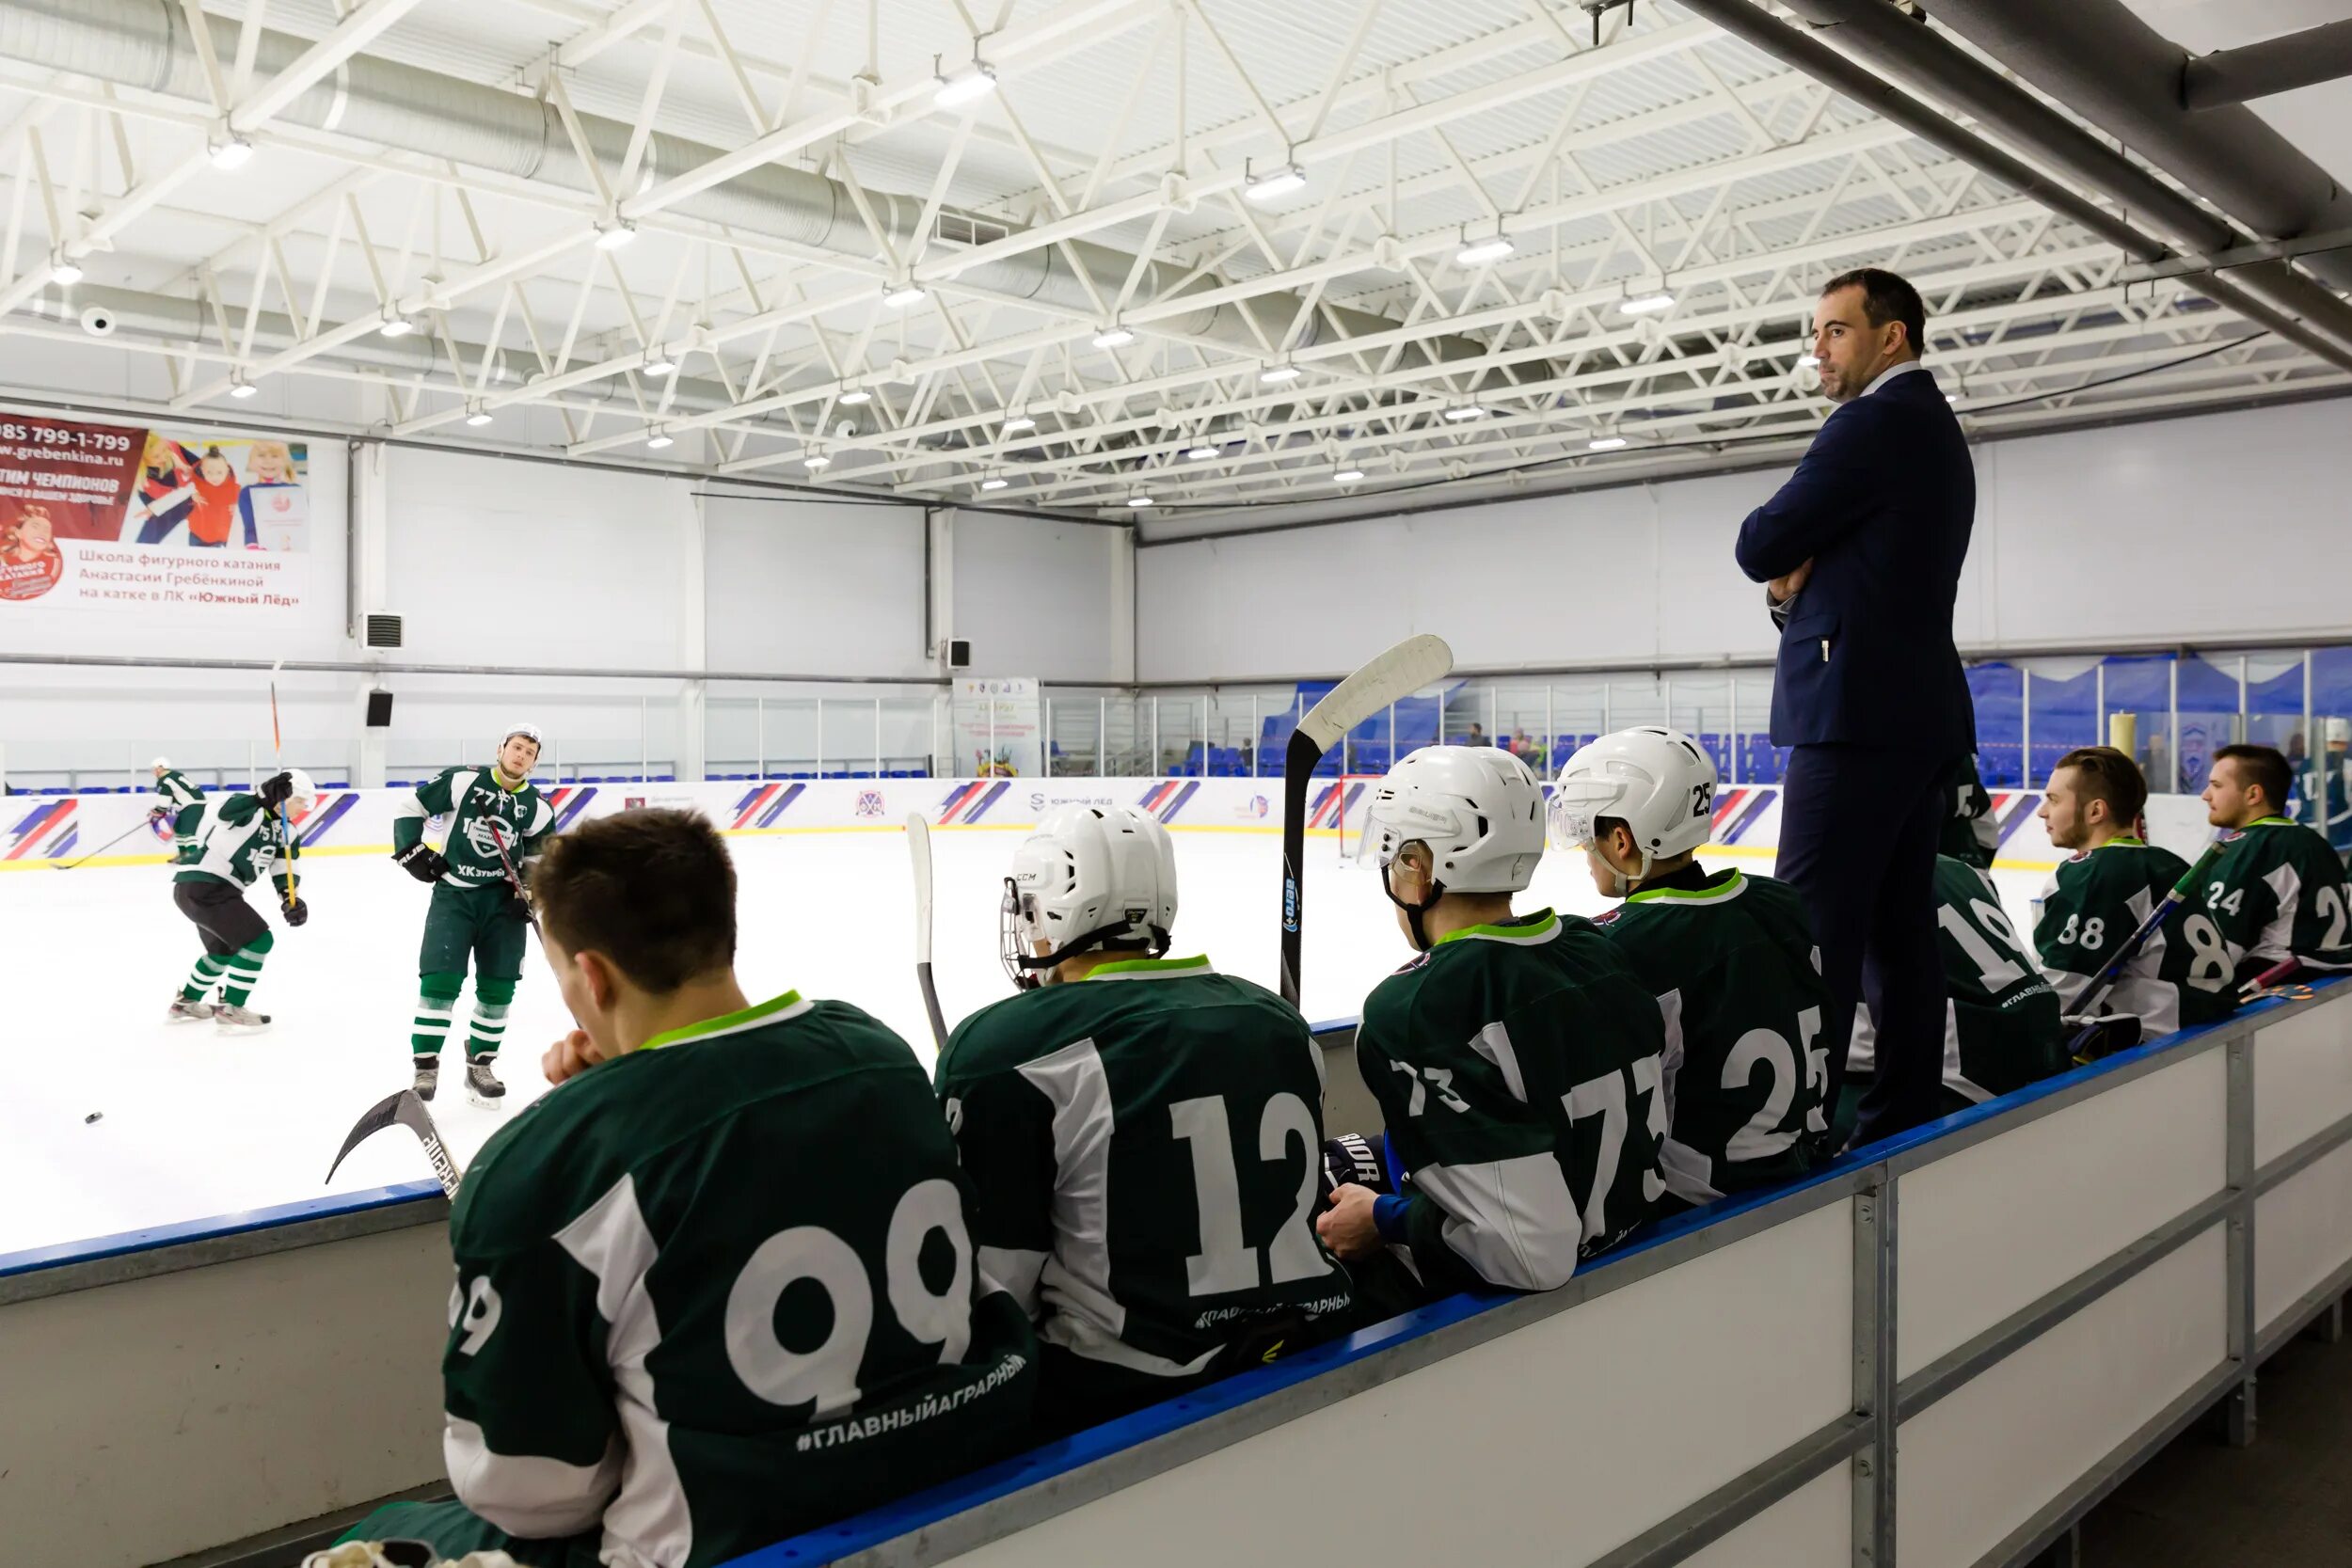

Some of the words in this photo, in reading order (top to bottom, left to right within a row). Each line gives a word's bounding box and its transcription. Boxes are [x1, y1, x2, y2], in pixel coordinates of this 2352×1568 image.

[32, 426, 131, 451] 799-1-799
[32, 472, 119, 493] ЧЕМПИОНОВ
[79, 549, 134, 563] Школа
[138, 553, 219, 569] фигурного
[223, 558, 280, 570] катания
[79, 568, 162, 582] Анастасии
[166, 572, 263, 587] Гребёнкиной
[79, 588, 99, 597] на
[103, 590, 147, 600] катке
[151, 592, 159, 600] в
[164, 591, 184, 601] ЛК
[189, 592, 259, 604] «Южный
[262, 594, 299, 607] Лёд»
[1692, 782, 1710, 817] 25
[456, 864, 475, 877] ХК
[1016, 873, 1037, 881] CCM
[2207, 880, 2245, 916] 24
[2058, 913, 2105, 951] 88
[1389, 1059, 1471, 1117] 73
[1721, 1004, 1831, 1163] 25
[1332, 1132, 1380, 1182] RIOR
[1168, 1092, 1335, 1297] 12
[724, 1178, 973, 1424] 99
